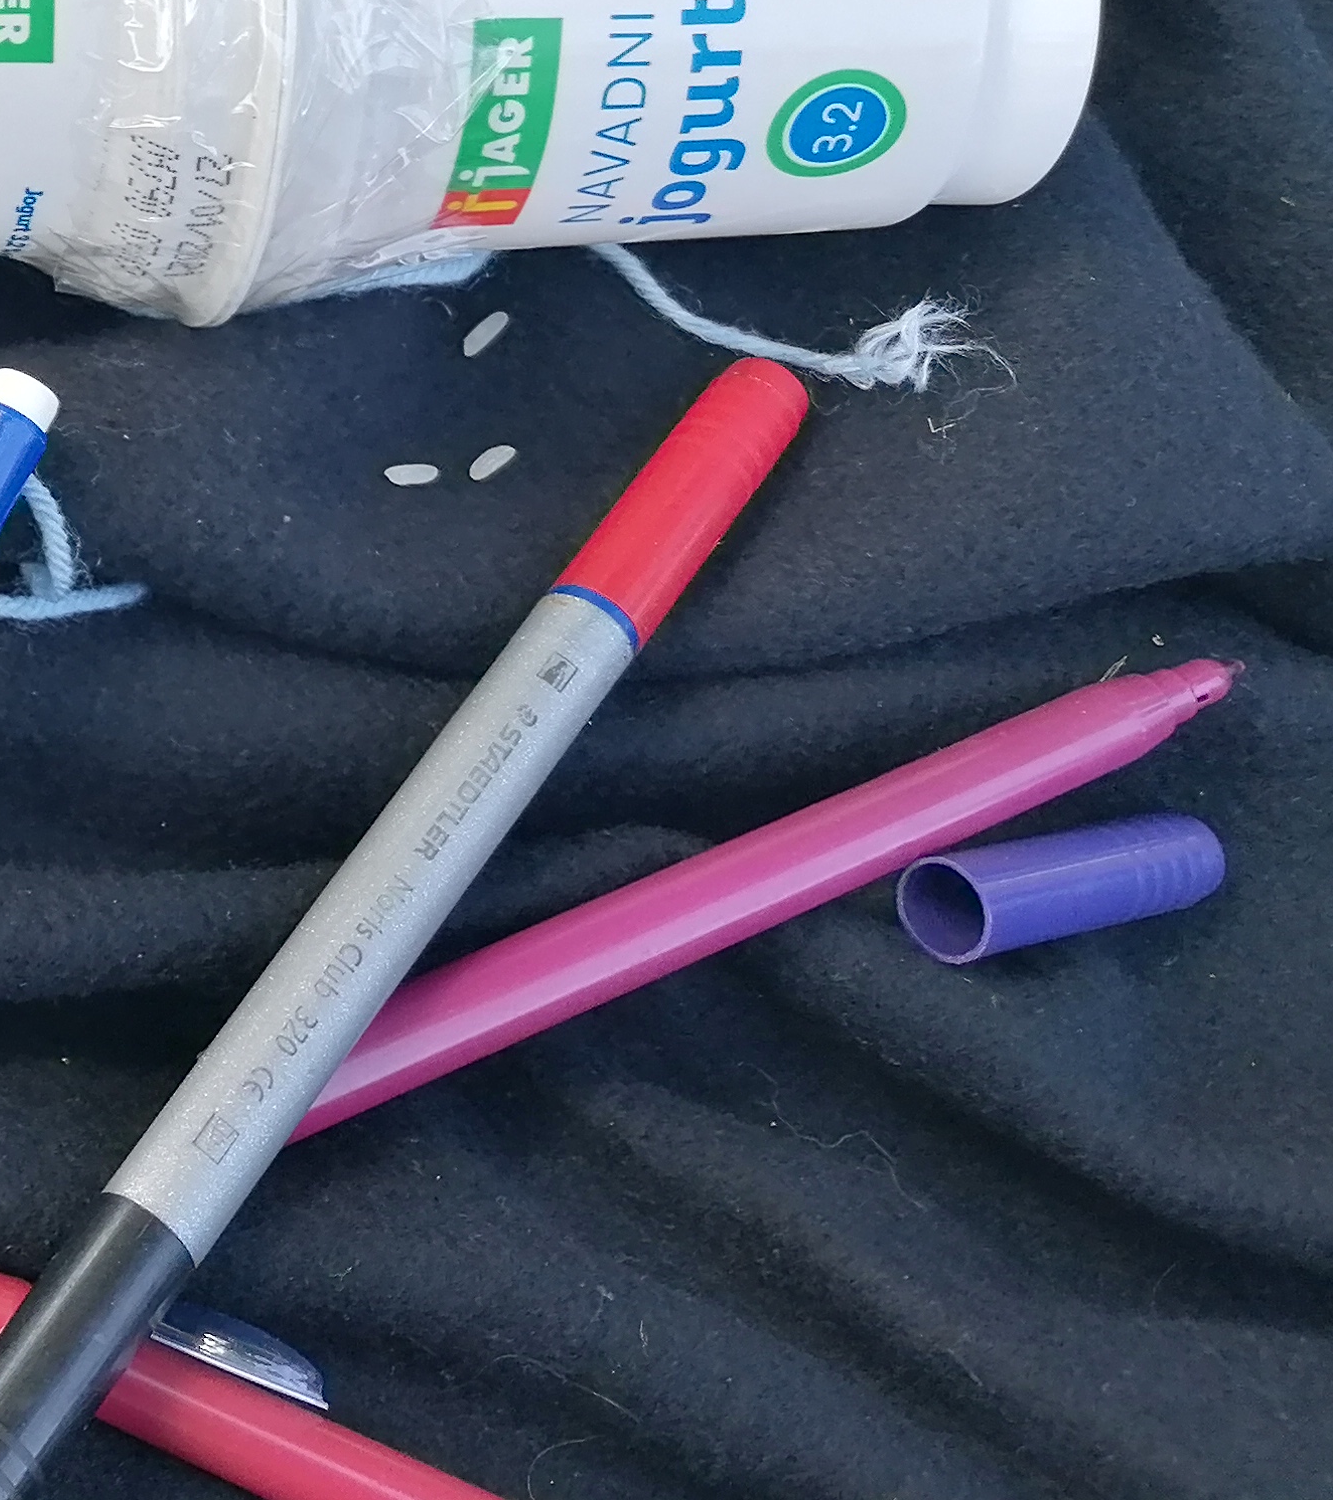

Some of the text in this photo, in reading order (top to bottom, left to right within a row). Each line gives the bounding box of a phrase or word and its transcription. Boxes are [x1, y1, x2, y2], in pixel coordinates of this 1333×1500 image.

[558, 13, 655, 224] NAVADNI
[811, 100, 865, 156] 3.2
[12, 187, 44, 233] Jogurt
[413, 727, 522, 862] STAEDTLER
[355, 873, 414, 941] Noris
[314, 942, 365, 999] Club
[275, 1004, 320, 1059] 320
